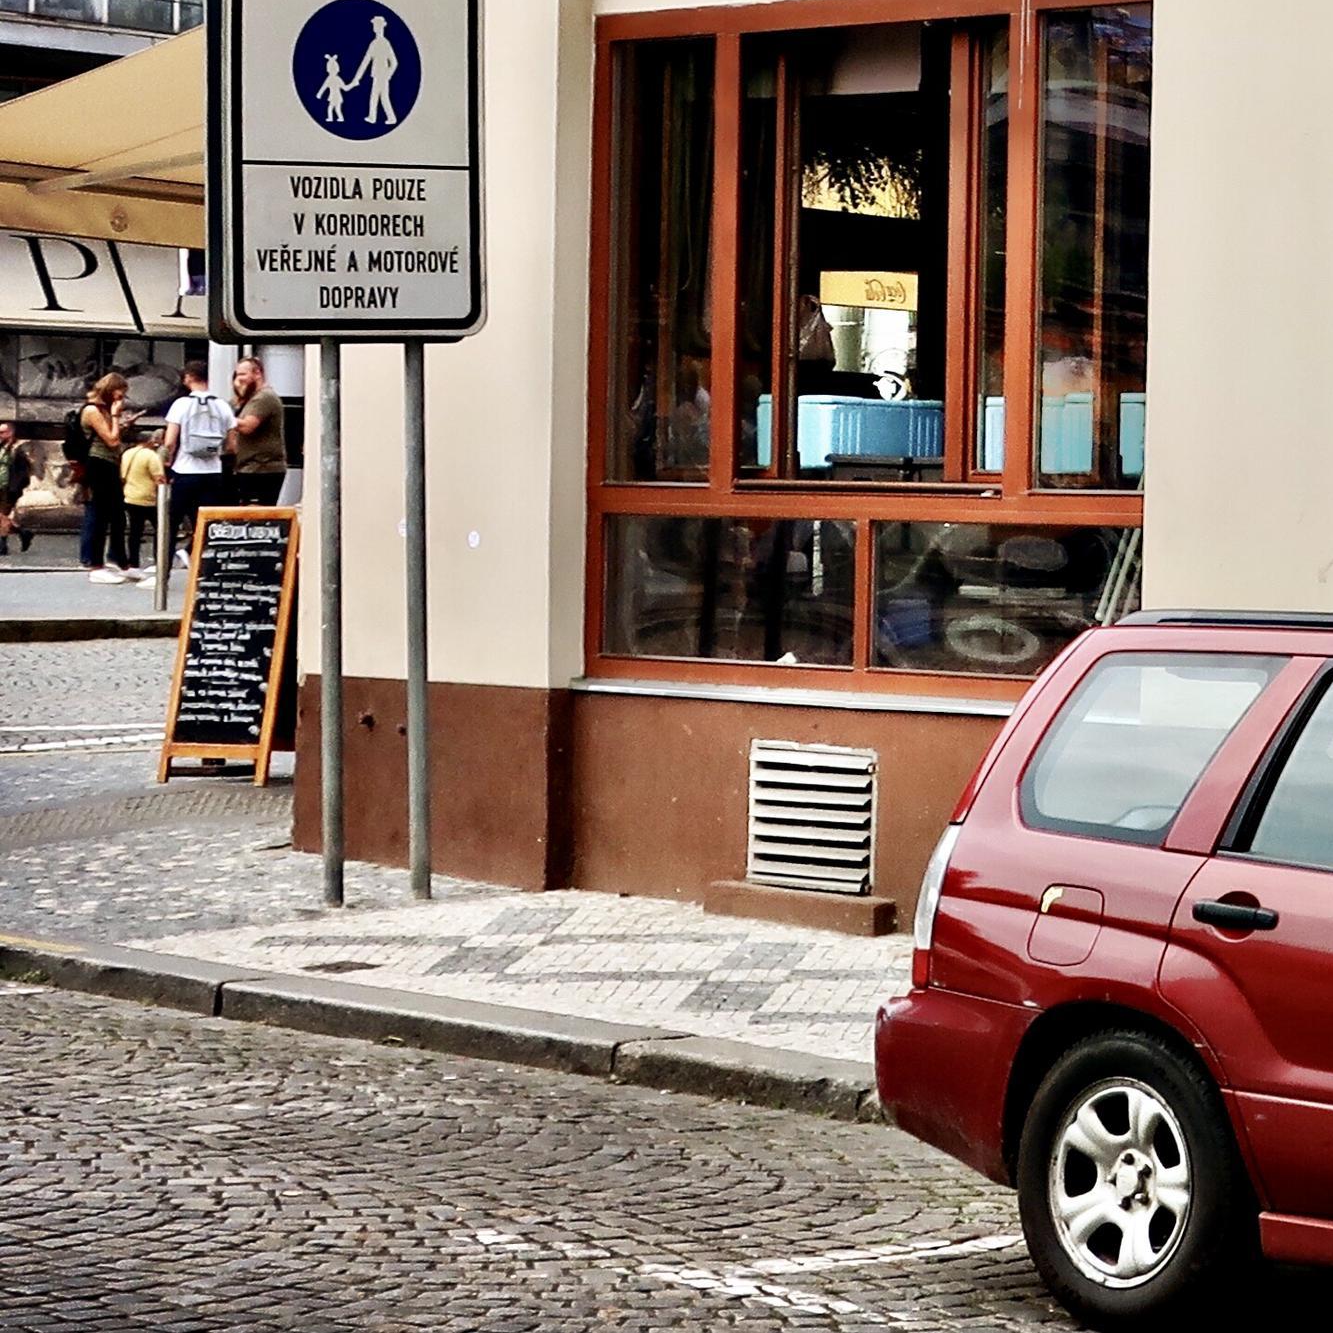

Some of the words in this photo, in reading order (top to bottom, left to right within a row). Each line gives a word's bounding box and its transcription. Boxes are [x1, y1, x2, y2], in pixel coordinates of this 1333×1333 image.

[290, 176, 363, 200] VOZIDLA
[373, 178, 426, 201] POUZE
[293, 213, 306, 236] V
[315, 213, 425, 238] KORIDORECH
[256, 243, 337, 273] VEŘEJNÉ
[346, 250, 359, 273] A
[368, 245, 460, 274] MOTOROVÉ
[319, 286, 400, 309] DOPRAVY
